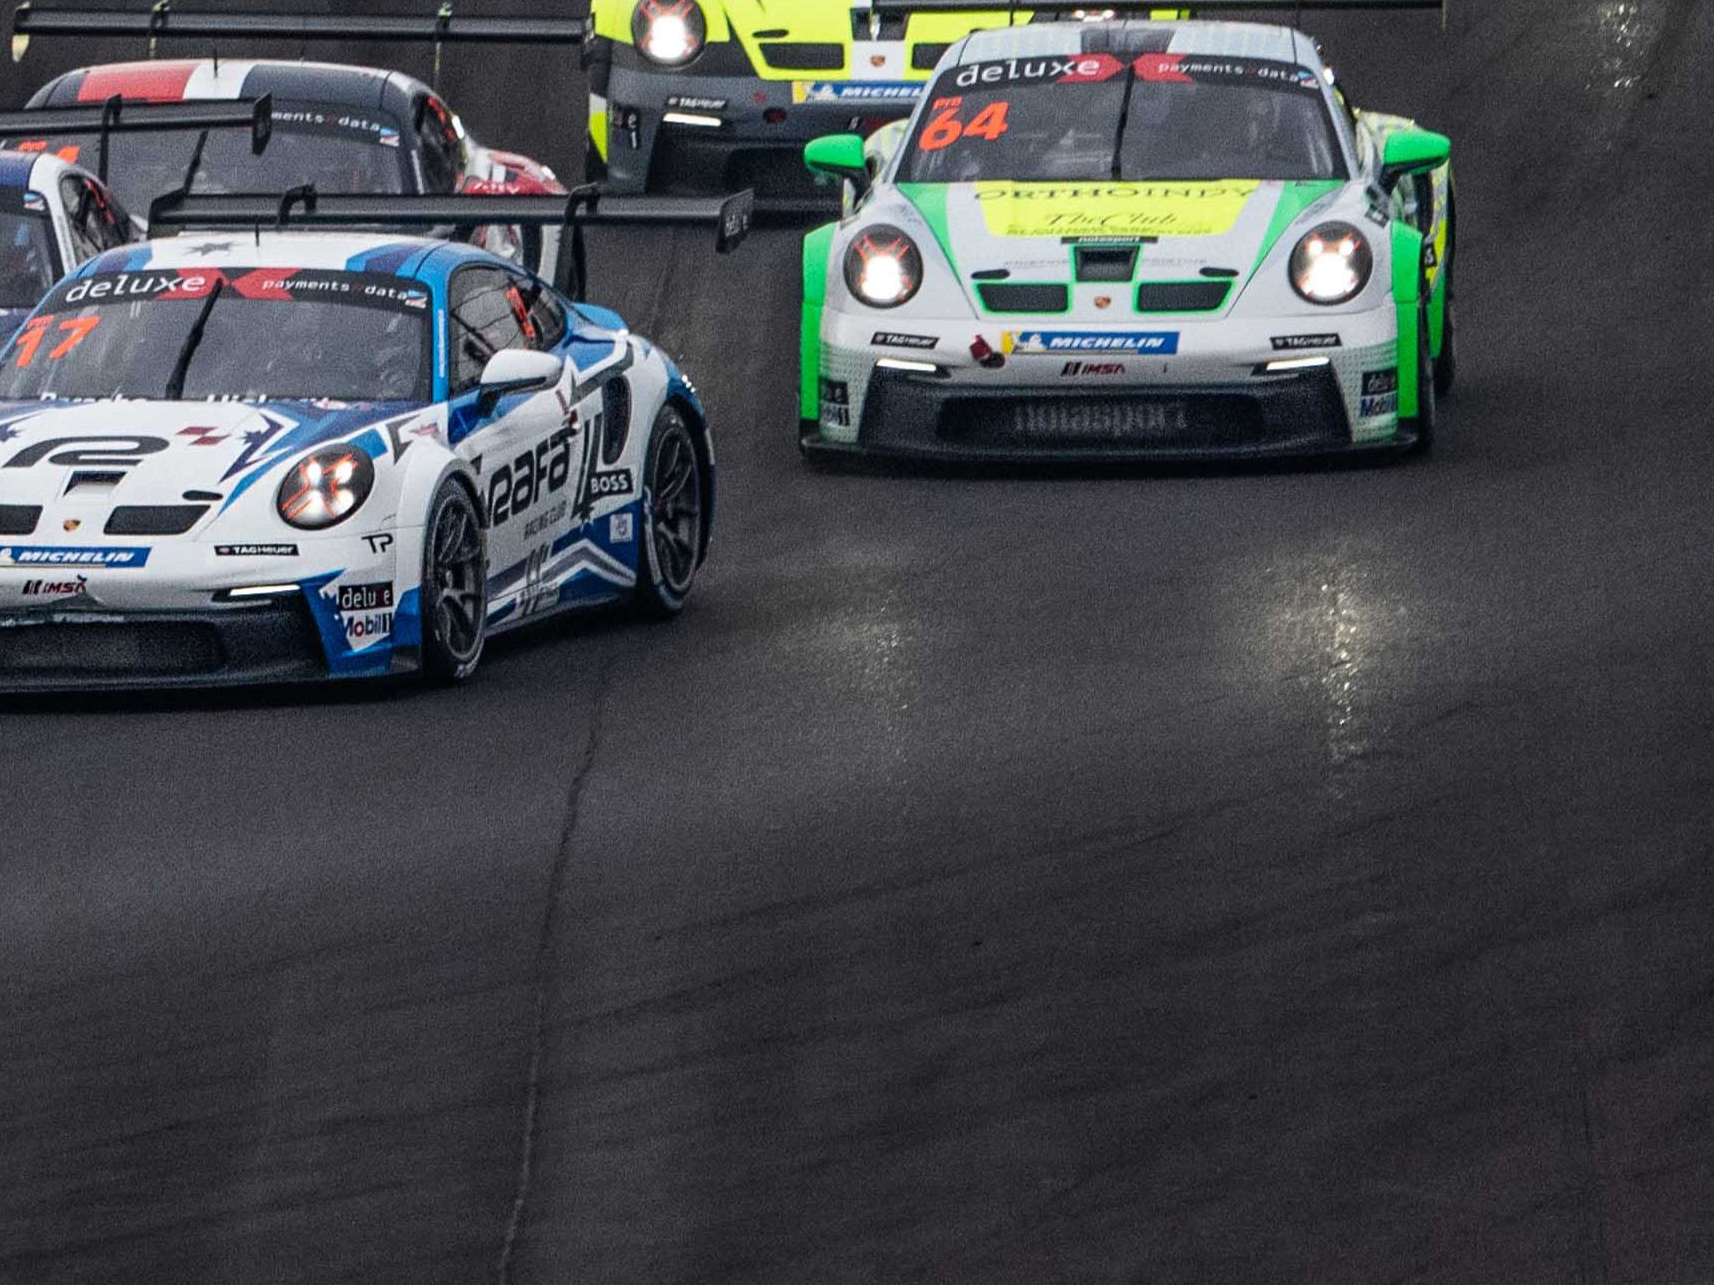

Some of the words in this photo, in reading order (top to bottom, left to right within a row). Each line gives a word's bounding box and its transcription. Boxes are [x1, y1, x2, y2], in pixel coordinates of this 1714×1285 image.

[955, 57, 1101, 87] deluxe
[1157, 62, 1243, 76] payments
[1257, 67, 1300, 82] data
[272, 111, 326, 126] ments
[338, 115, 382, 131] data
[918, 101, 1009, 152] 64
[64, 275, 206, 303] deluxe
[262, 279, 350, 294] payments
[364, 284, 408, 302] data
[15, 316, 101, 368] 17
[1048, 336, 1167, 350] MICHELIN
[1081, 362, 1126, 374] IMSA
[591, 472, 629, 494] BOSS
[17, 549, 135, 564] MICHELIN
[43, 580, 87, 594] IMSA
[342, 586, 393, 608] delue
